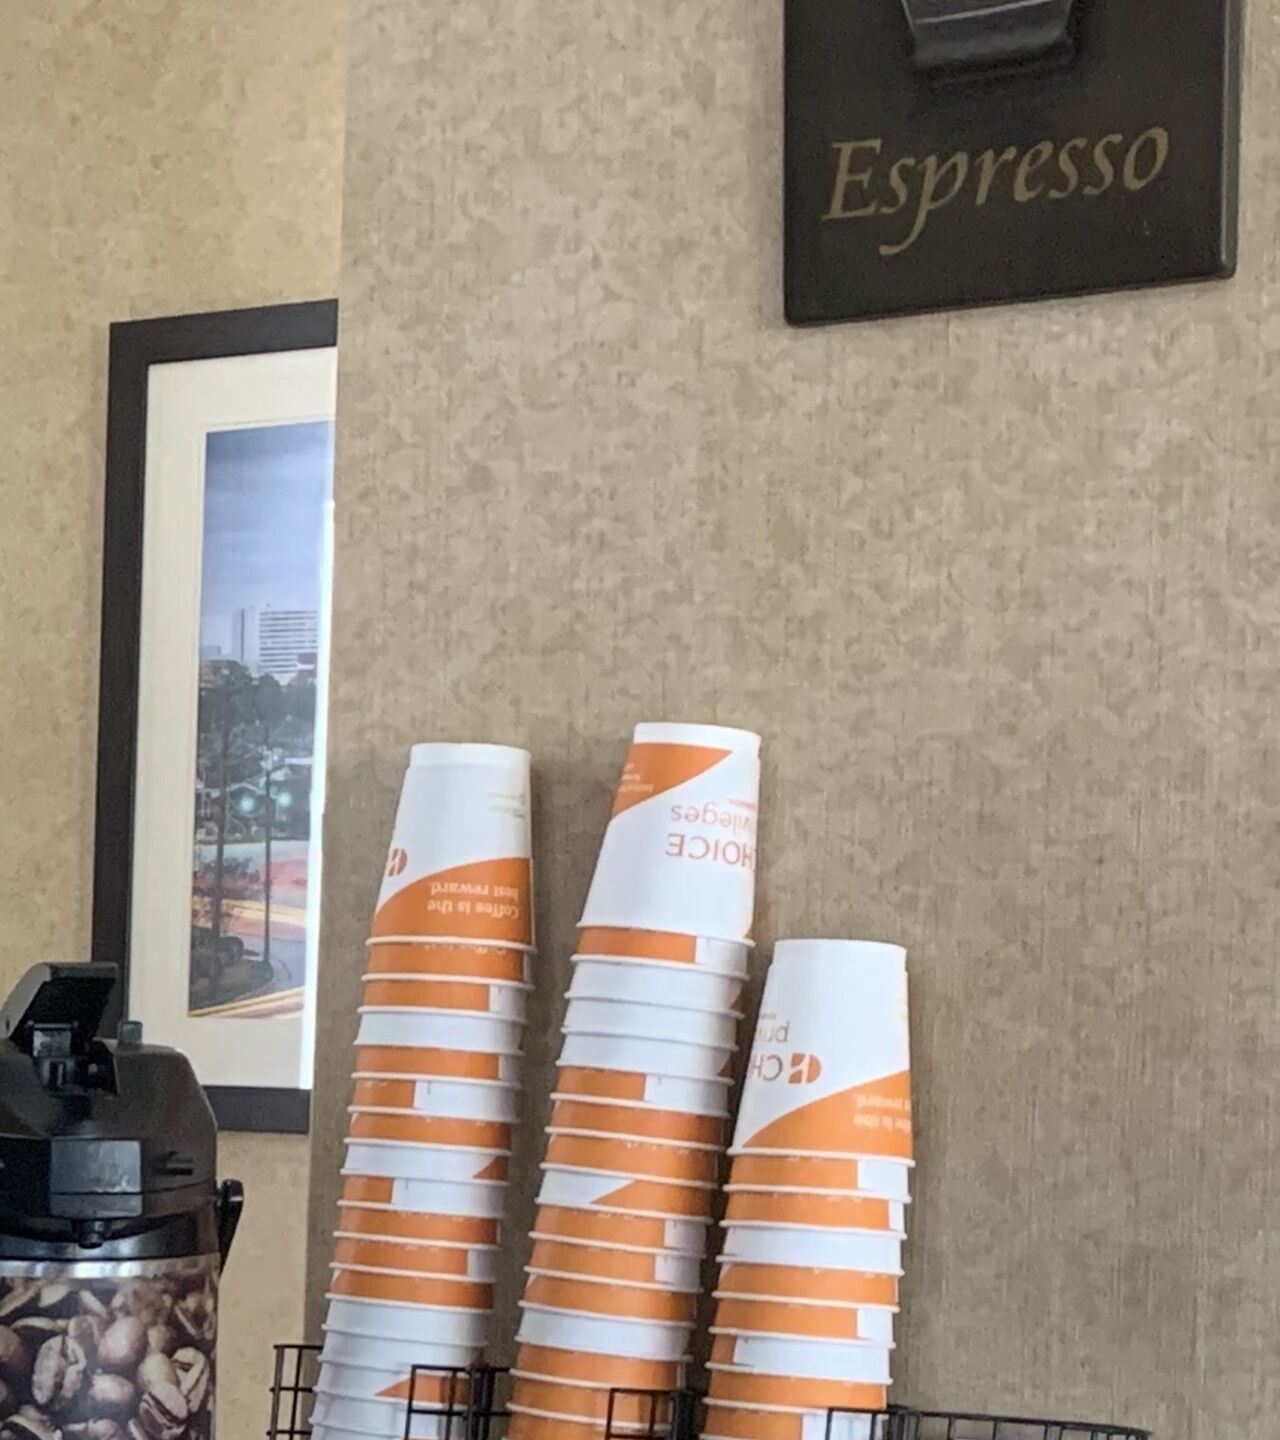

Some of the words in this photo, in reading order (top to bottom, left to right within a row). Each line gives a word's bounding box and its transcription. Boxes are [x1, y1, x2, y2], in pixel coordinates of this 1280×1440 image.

[821, 126, 1170, 257] Espresso
[665, 833, 754, 868] HOICE
[426, 899, 453, 915] the
[475, 901, 520, 920] Coffee
